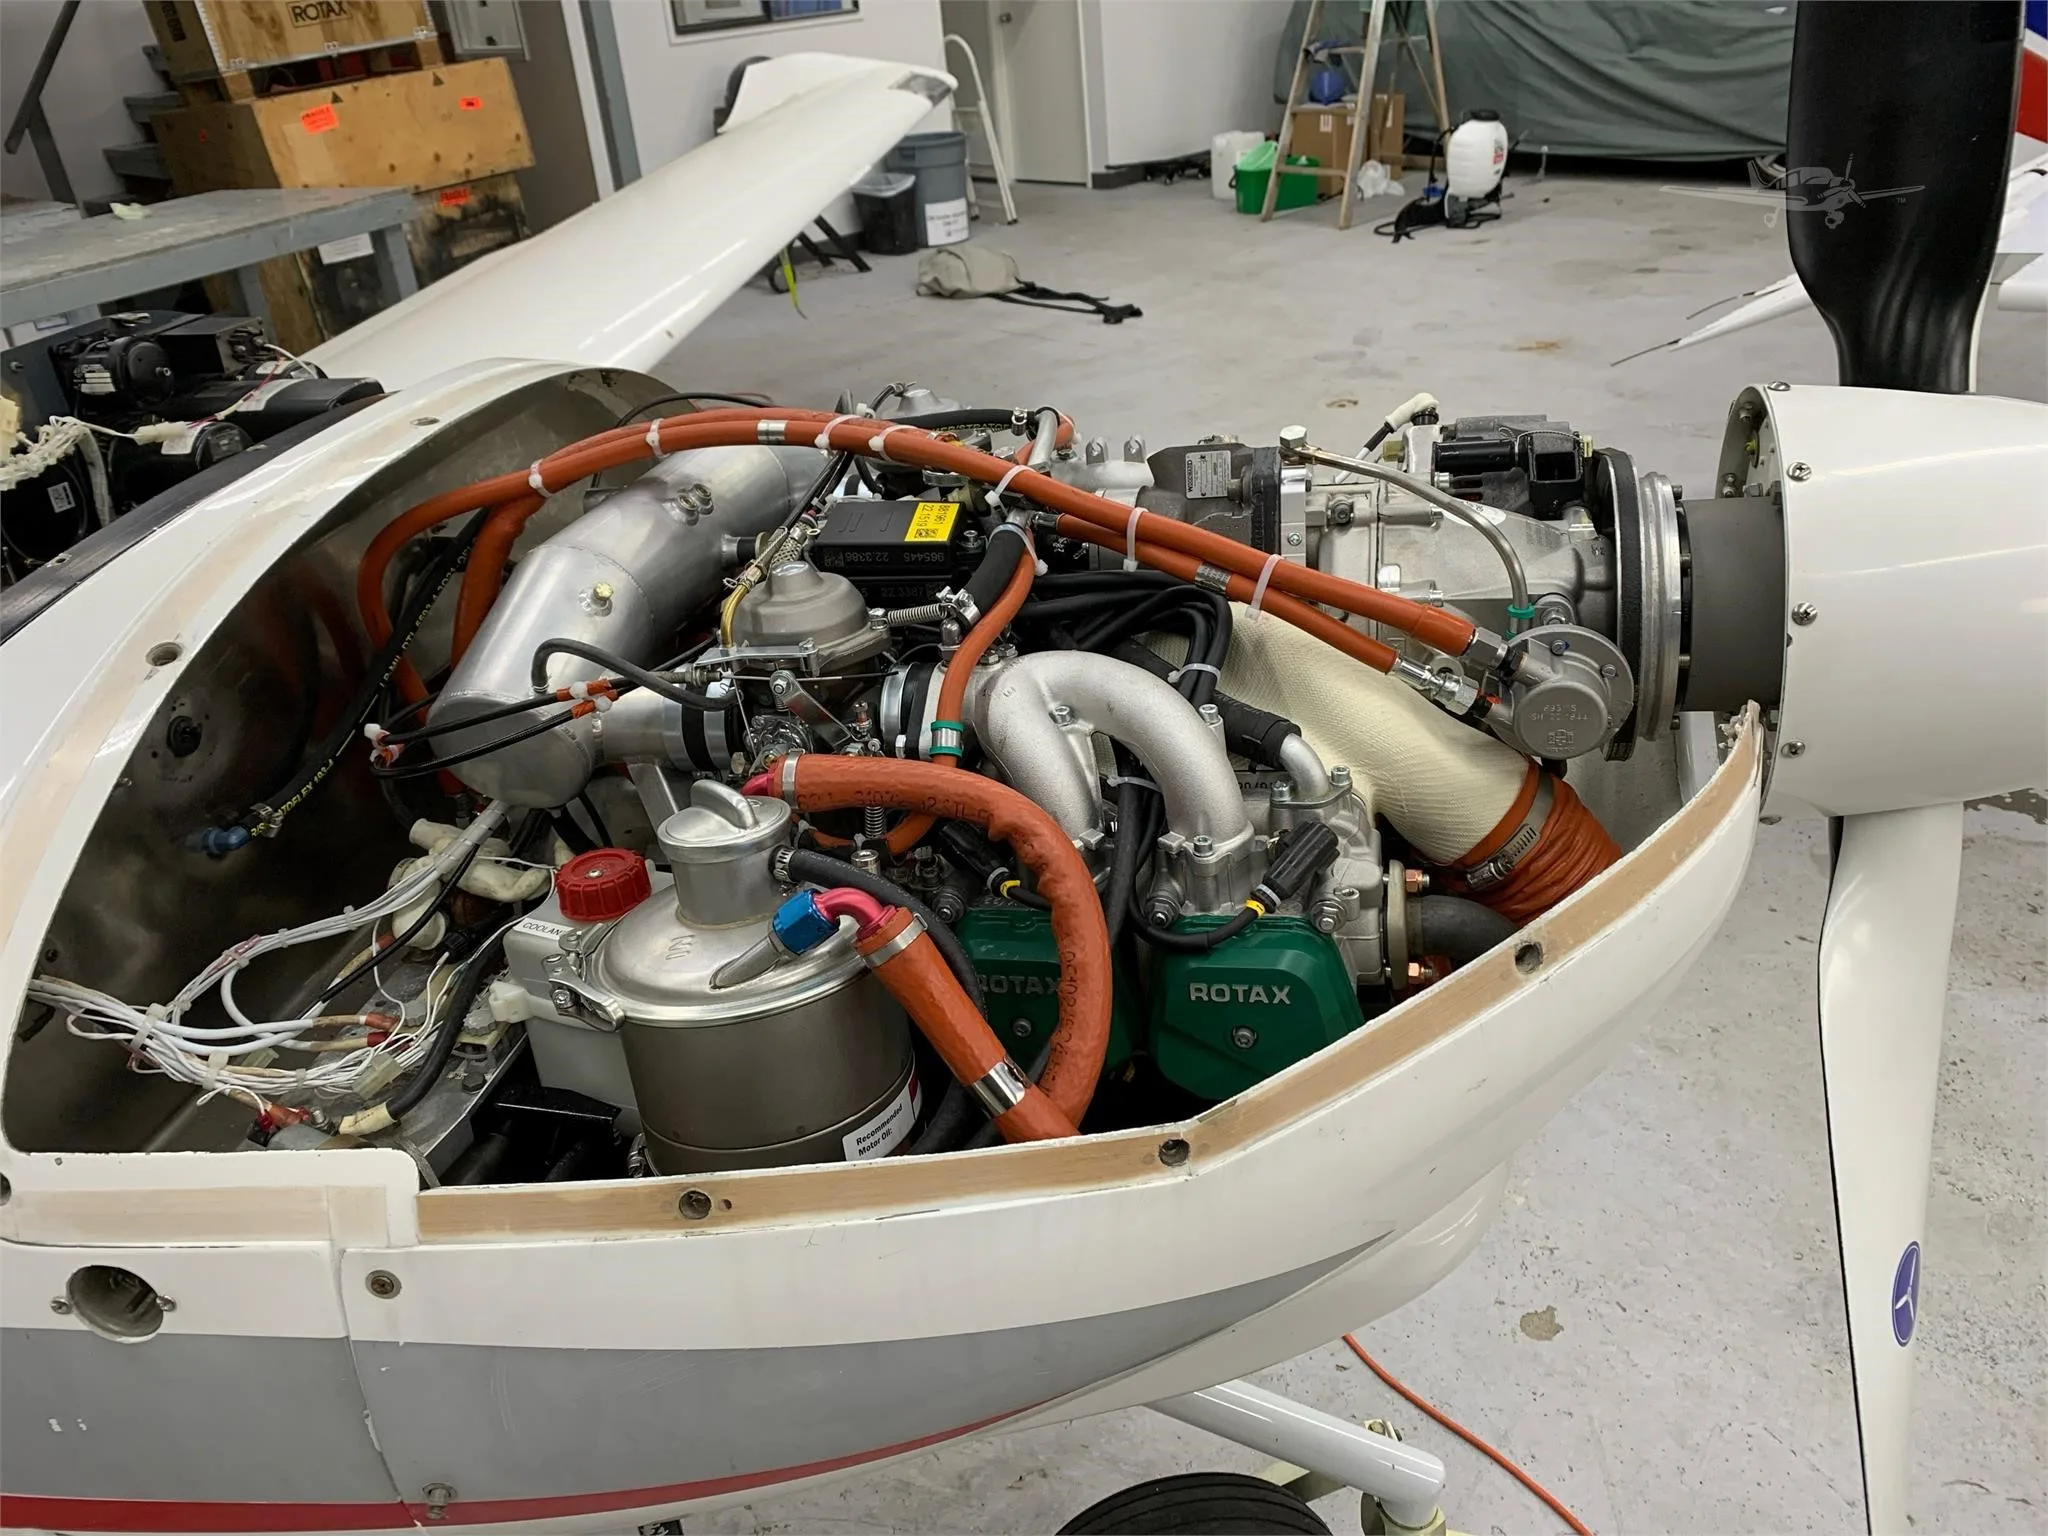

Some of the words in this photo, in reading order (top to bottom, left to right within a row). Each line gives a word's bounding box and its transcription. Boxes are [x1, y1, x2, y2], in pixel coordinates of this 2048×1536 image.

[291, 0, 347, 23] ROTAX
[523, 922, 565, 936] COOLAN
[1189, 982, 1291, 1005] ROTAX
[855, 1103, 903, 1146] Recommended
[857, 1139, 881, 1157] Motor
[881, 1128, 893, 1140] Oil:
